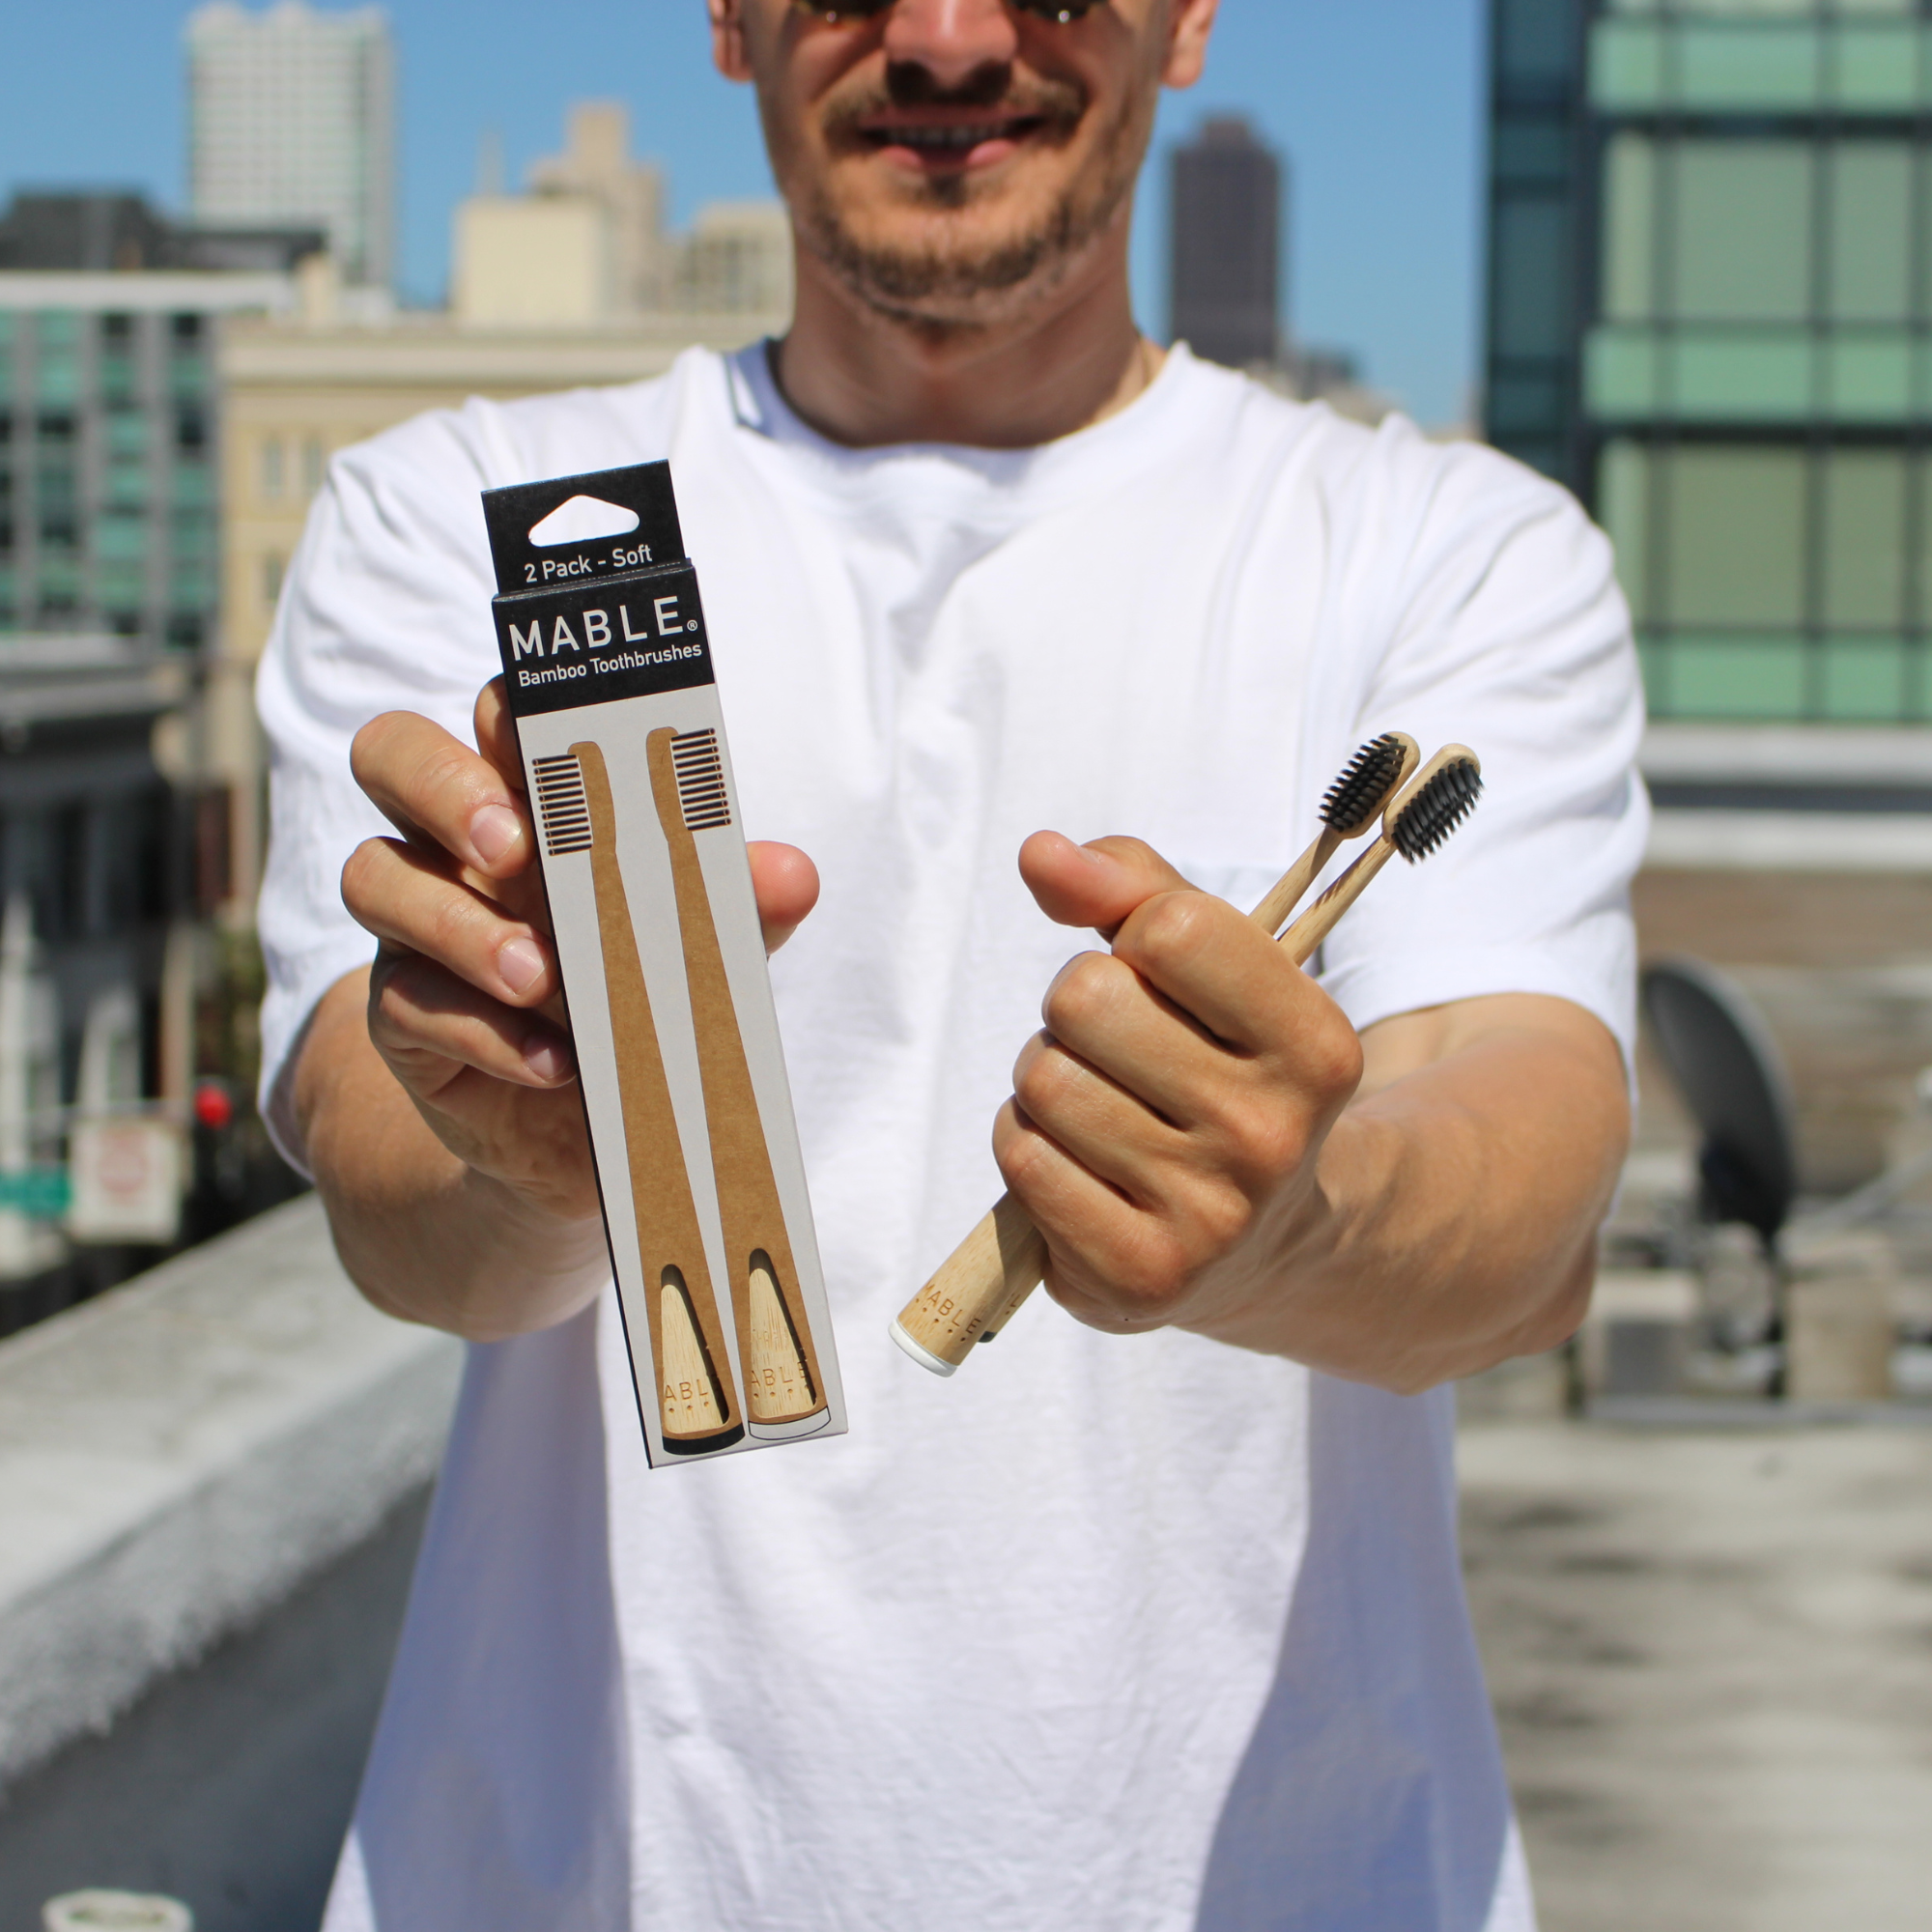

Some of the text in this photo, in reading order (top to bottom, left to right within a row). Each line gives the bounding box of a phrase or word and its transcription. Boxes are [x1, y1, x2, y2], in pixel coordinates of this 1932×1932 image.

[525, 563, 538, 582] 2
[542, 554, 591, 580] Pack
[611, 544, 653, 568] Soft
[518, 643, 702, 688] Bamboo Toothbrushes
